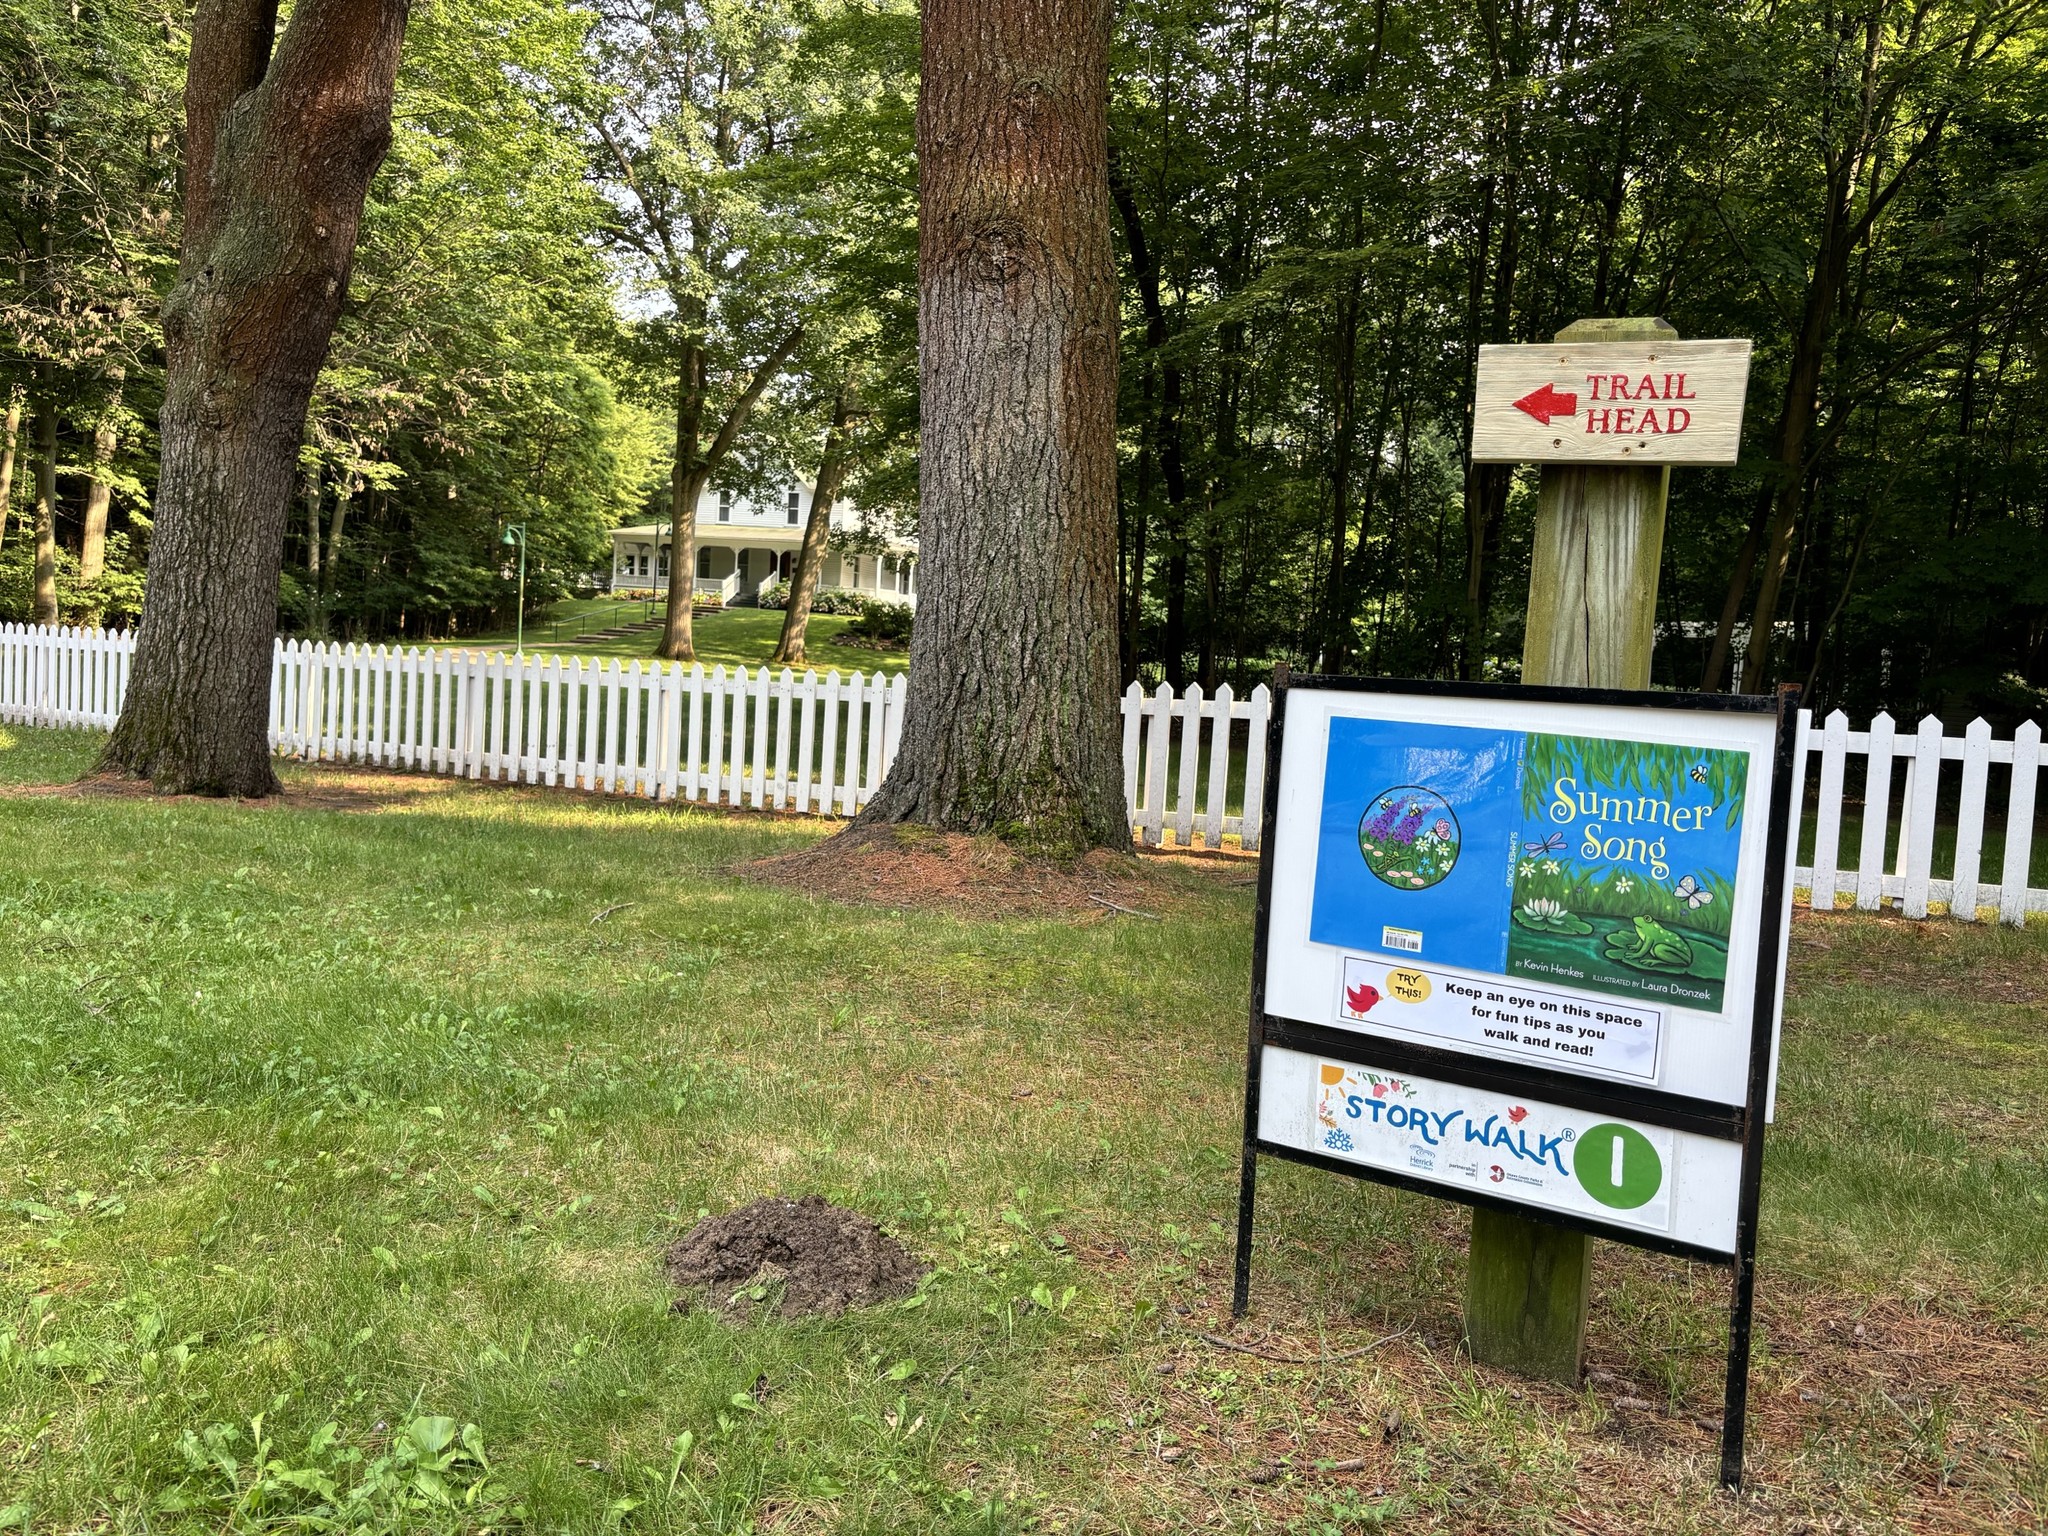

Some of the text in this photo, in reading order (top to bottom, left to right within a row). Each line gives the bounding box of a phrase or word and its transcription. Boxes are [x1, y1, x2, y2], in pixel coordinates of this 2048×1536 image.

[1586, 373, 1696, 400] TRAIL
[1585, 407, 1691, 434] HEAD
[1550, 777, 1713, 833] Summer
[1506, 831, 1519, 888] SUMMER SONG
[1581, 824, 1670, 881] Song
[1395, 985, 1422, 999] THIS!
[1396, 972, 1422, 985] TRY
[1515, 958, 1711, 1001] BY Kevin Henkes ILLUSTRATED BY Laura Dronzek
[1445, 982, 1643, 1028] Keep an eye on this space
[1471, 1006, 1606, 1040] for fun tips as you
[1484, 1028, 1594, 1057] walk and read!
[1410, 1156, 1434, 1168] Herrick
[1448, 1163, 1476, 1173] partnership
